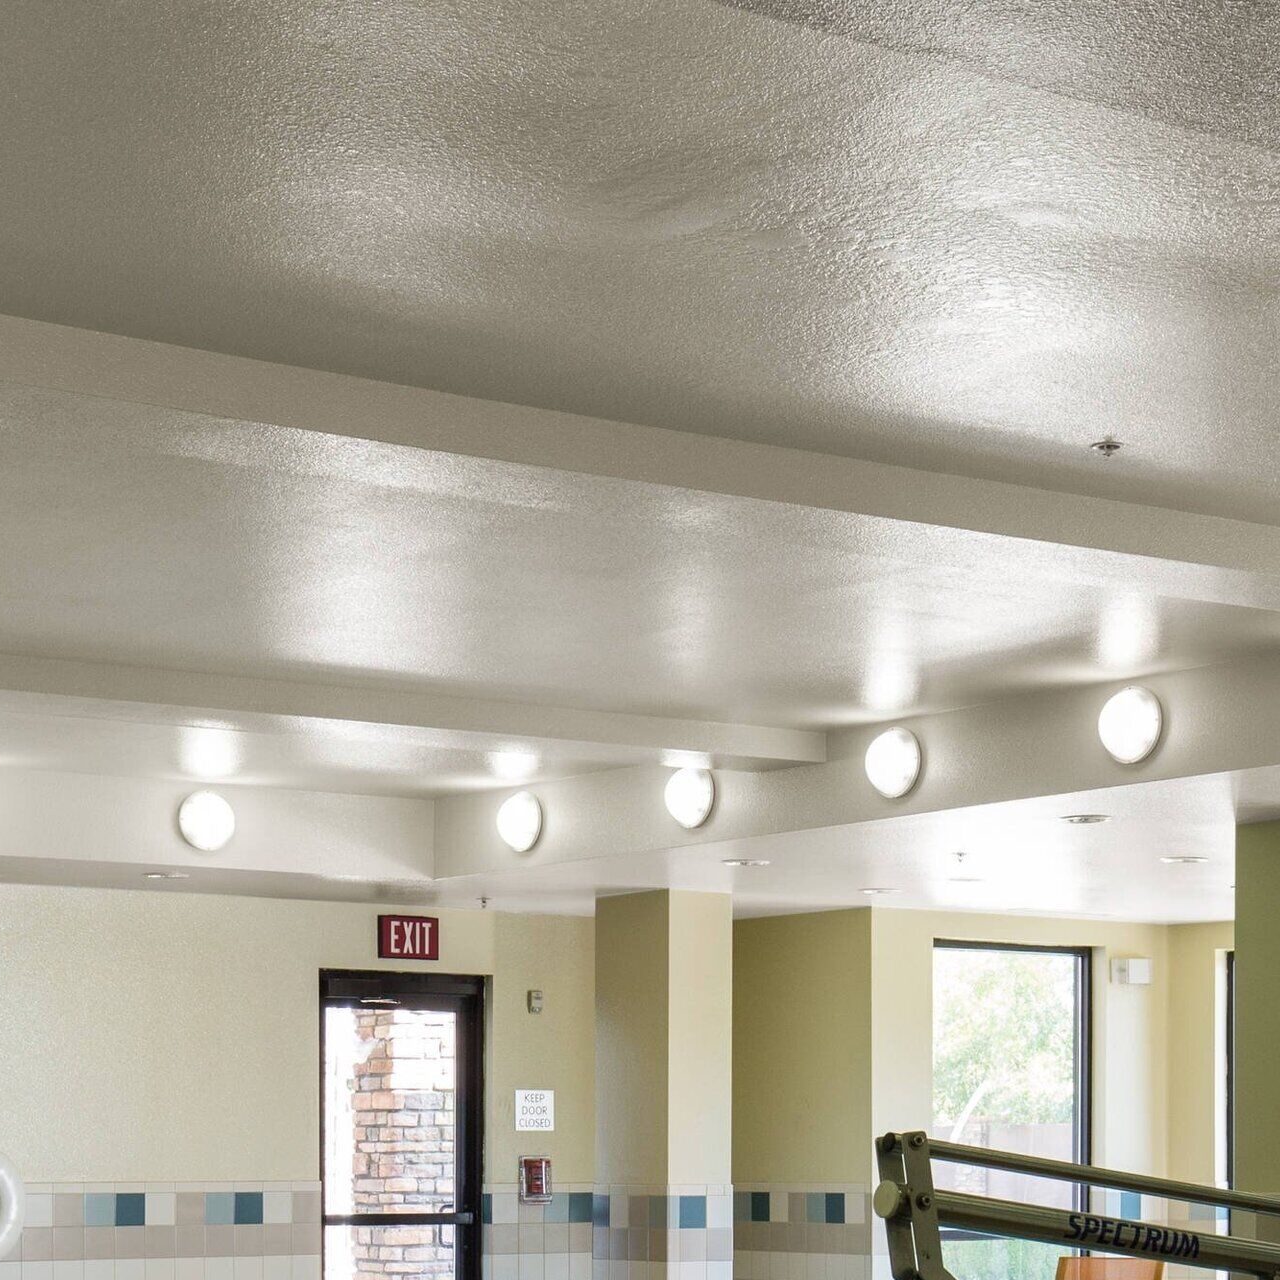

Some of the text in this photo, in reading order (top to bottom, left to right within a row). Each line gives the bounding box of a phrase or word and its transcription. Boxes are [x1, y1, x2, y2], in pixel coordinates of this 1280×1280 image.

[390, 920, 432, 954] EXIT
[524, 1093, 545, 1103] KEEP
[521, 1105, 548, 1116] DOOR
[518, 1118, 551, 1128] CLOSED
[1064, 1215, 1200, 1258] SPECTRUM
